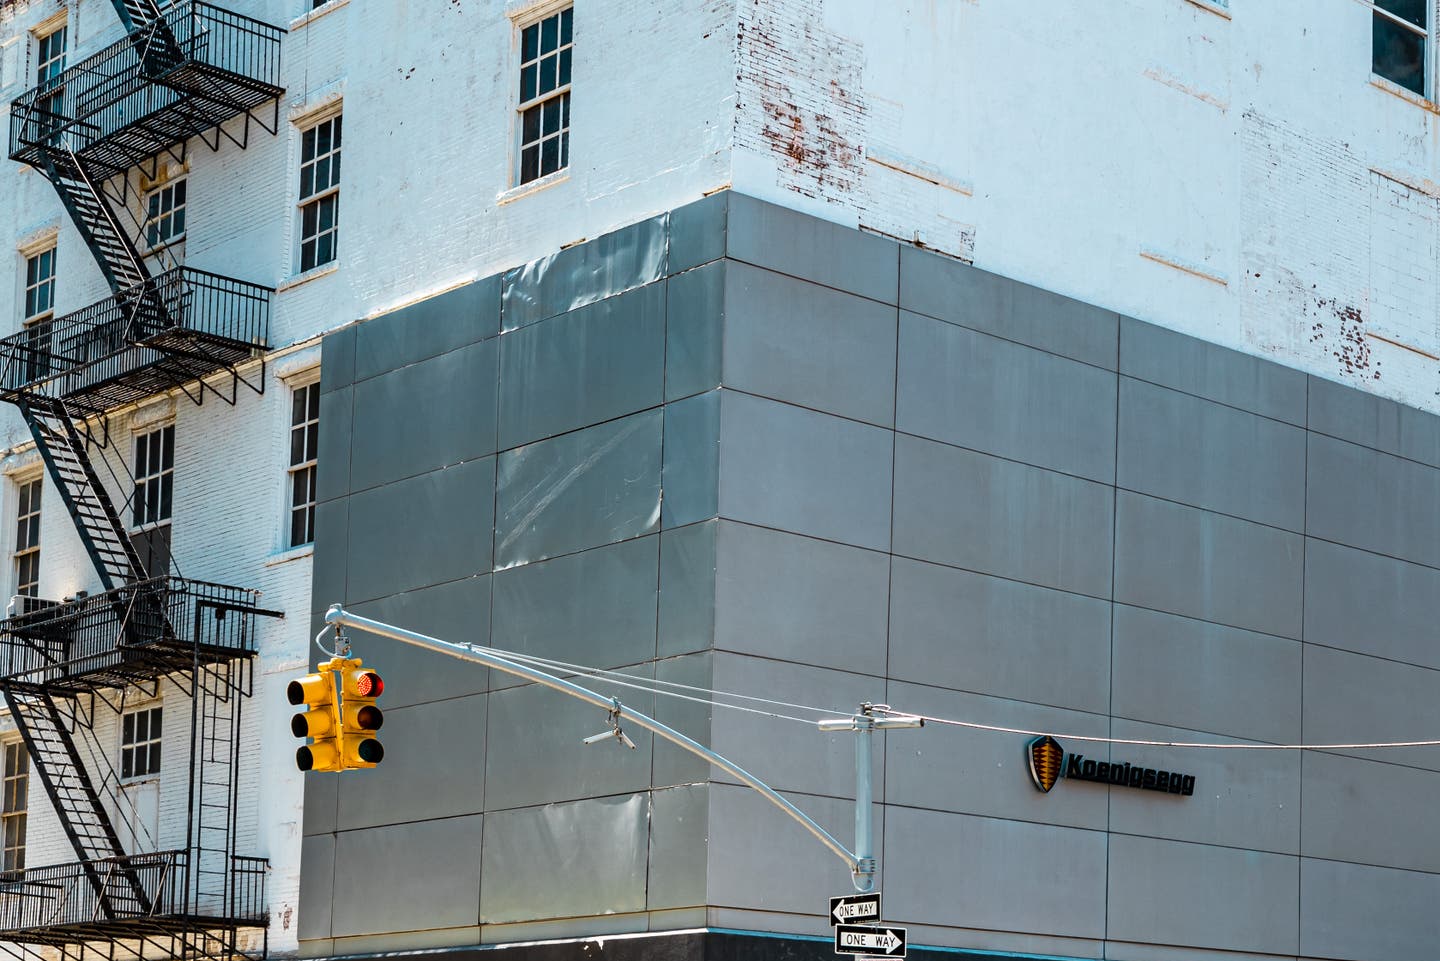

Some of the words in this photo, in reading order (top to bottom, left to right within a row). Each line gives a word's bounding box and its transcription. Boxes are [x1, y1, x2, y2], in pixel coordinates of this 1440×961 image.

[1066, 753, 1196, 796] Koenigsegg
[840, 905, 854, 917] ONE
[858, 903, 873, 915] WAY
[846, 934, 866, 946] ONE
[876, 935, 896, 948] WAY
